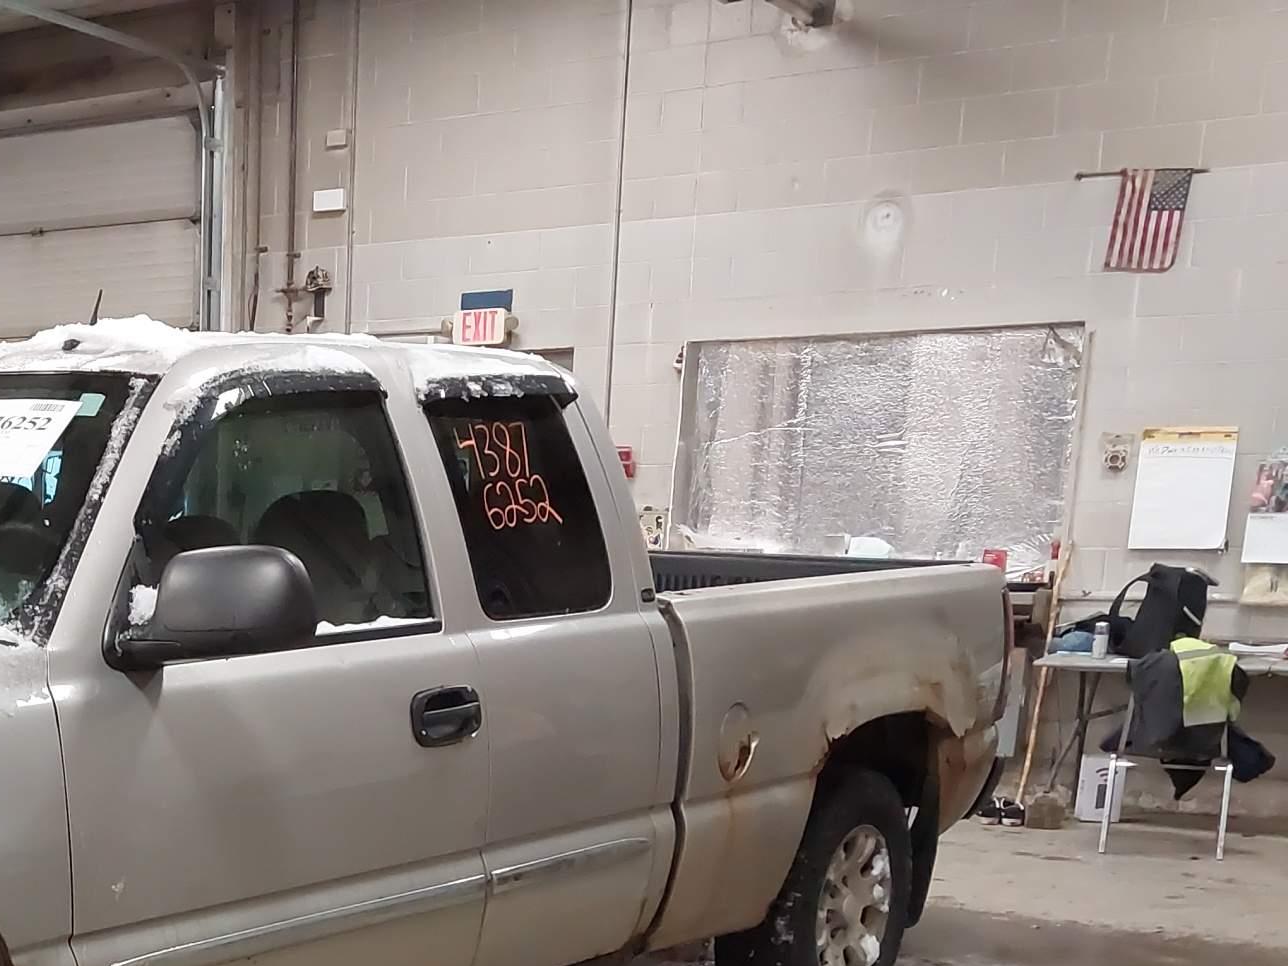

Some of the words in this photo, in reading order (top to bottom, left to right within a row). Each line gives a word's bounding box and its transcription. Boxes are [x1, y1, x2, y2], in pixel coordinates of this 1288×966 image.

[462, 311, 498, 342] EXIT
[453, 421, 530, 479] 4387
[483, 474, 563, 530] 6252
